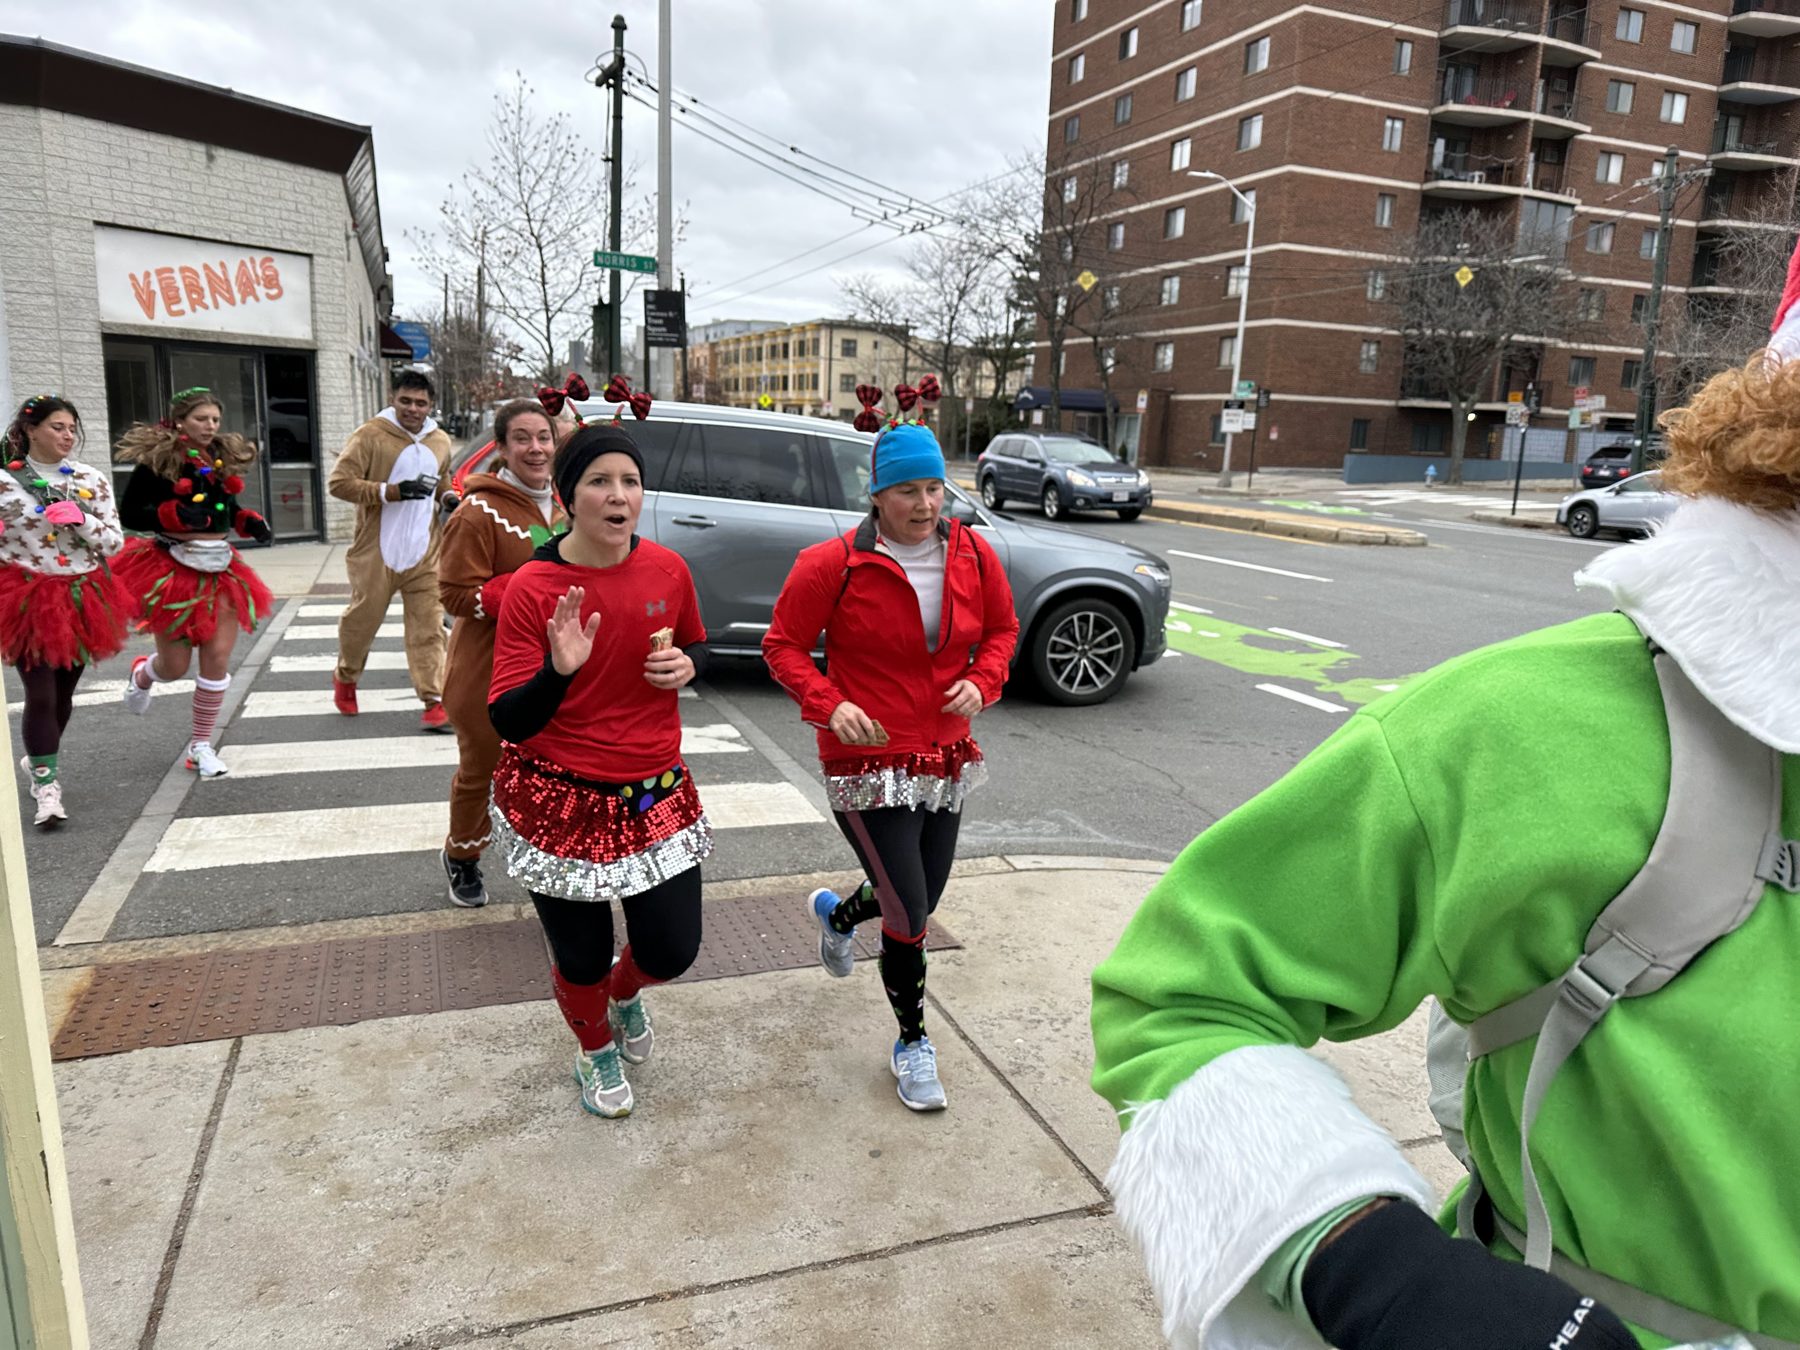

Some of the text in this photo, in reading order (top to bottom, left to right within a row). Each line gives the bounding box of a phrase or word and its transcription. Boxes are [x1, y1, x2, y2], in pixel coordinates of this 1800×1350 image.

[597, 254, 638, 268] NORRIS
[129, 256, 283, 320] VERNA'S
[898, 1060, 911, 1076] N
[1549, 1297, 1595, 1350] HEAD
